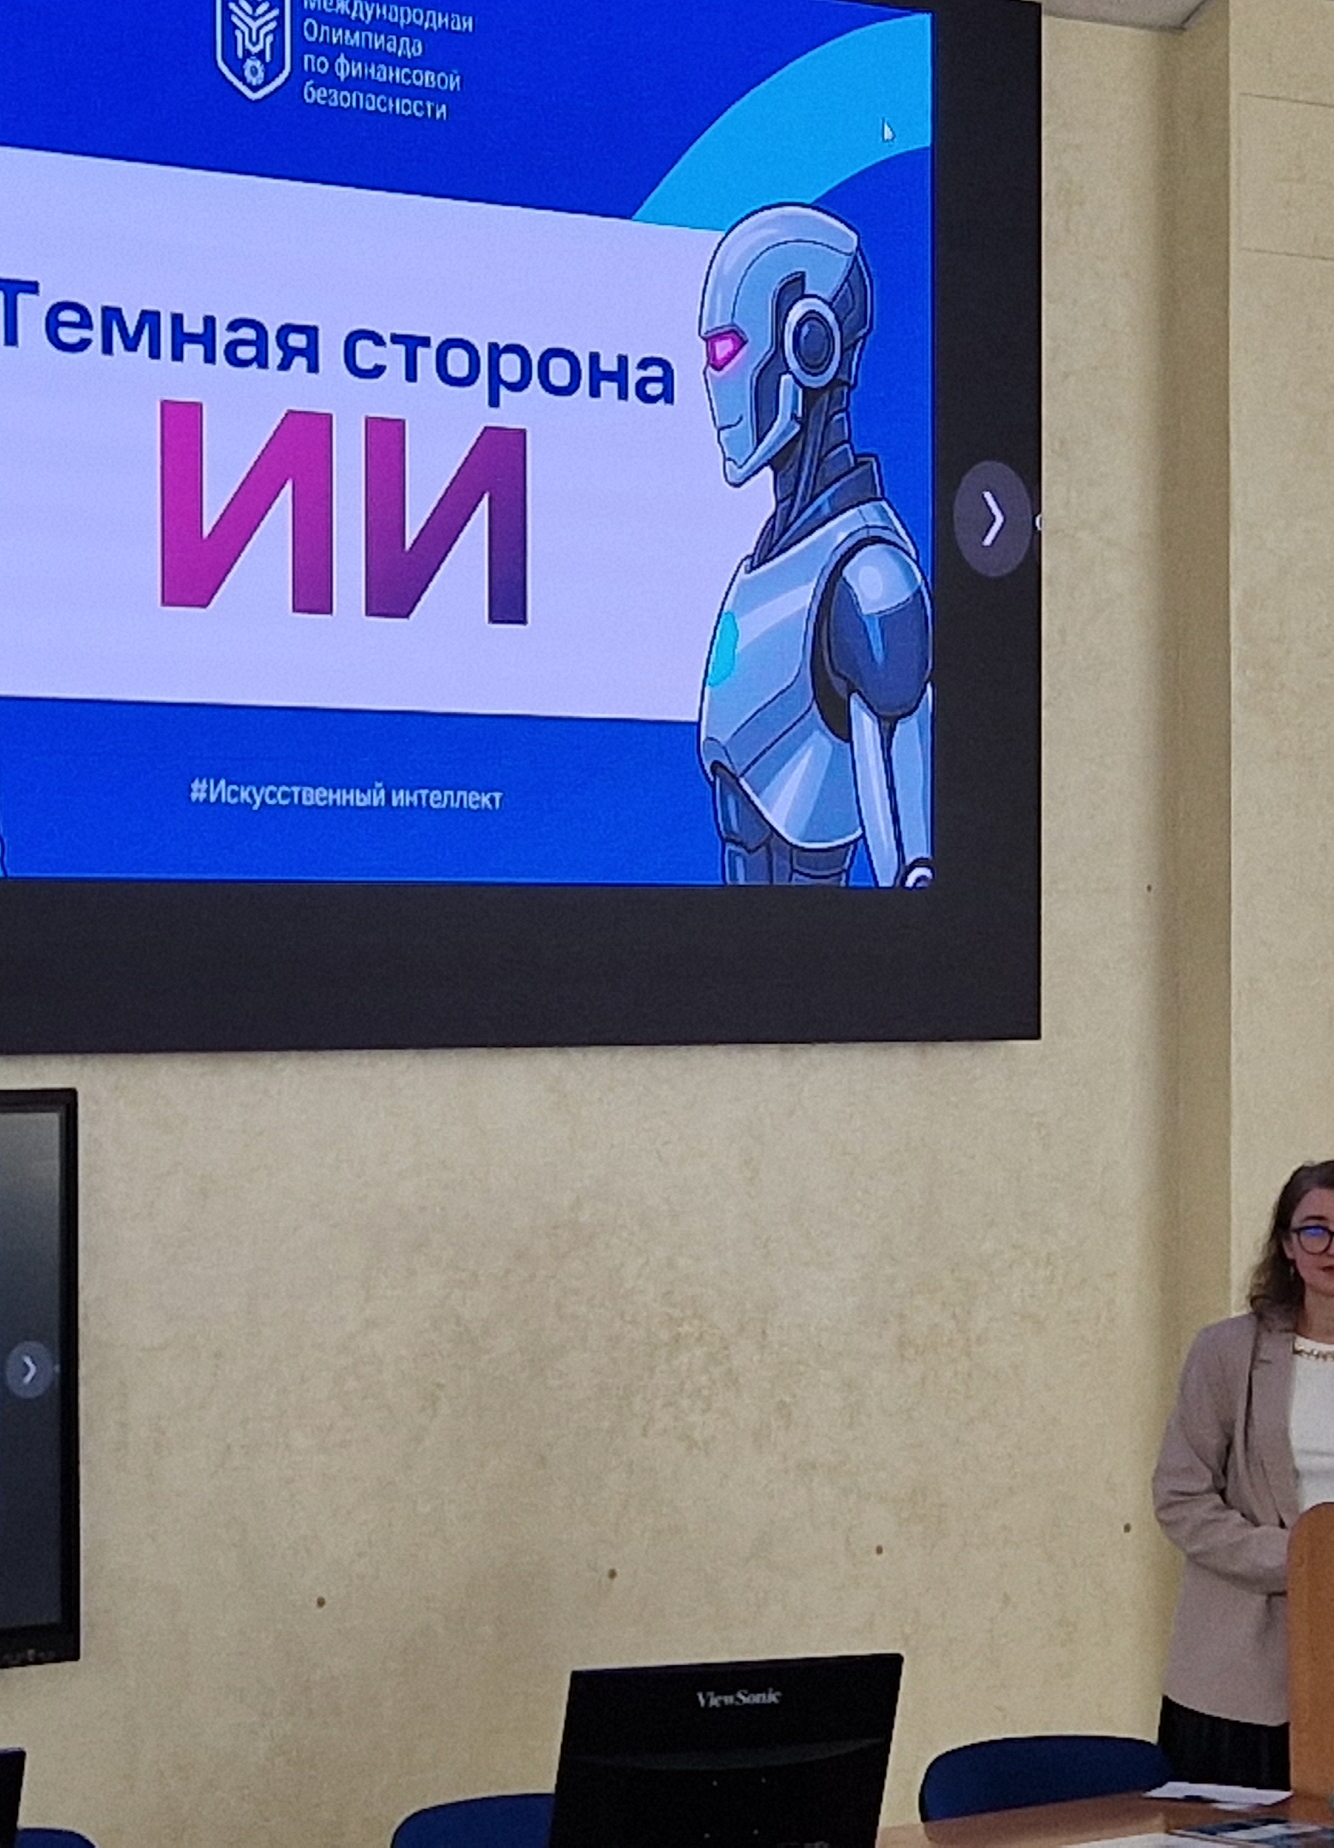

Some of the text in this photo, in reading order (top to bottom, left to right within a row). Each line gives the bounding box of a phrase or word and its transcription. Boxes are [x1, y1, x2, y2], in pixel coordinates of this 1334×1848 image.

[303, 17, 423, 57] Олимпиада
[303, 53, 462, 92] по финансовой
[303, 79, 448, 120] безопасности
[343, 328, 675, 408] сторона
[160, 399, 528, 626] ИИ
[190, 777, 503, 811] #Искусственный интеллект
[696, 1687, 782, 1708] ViewSonic
